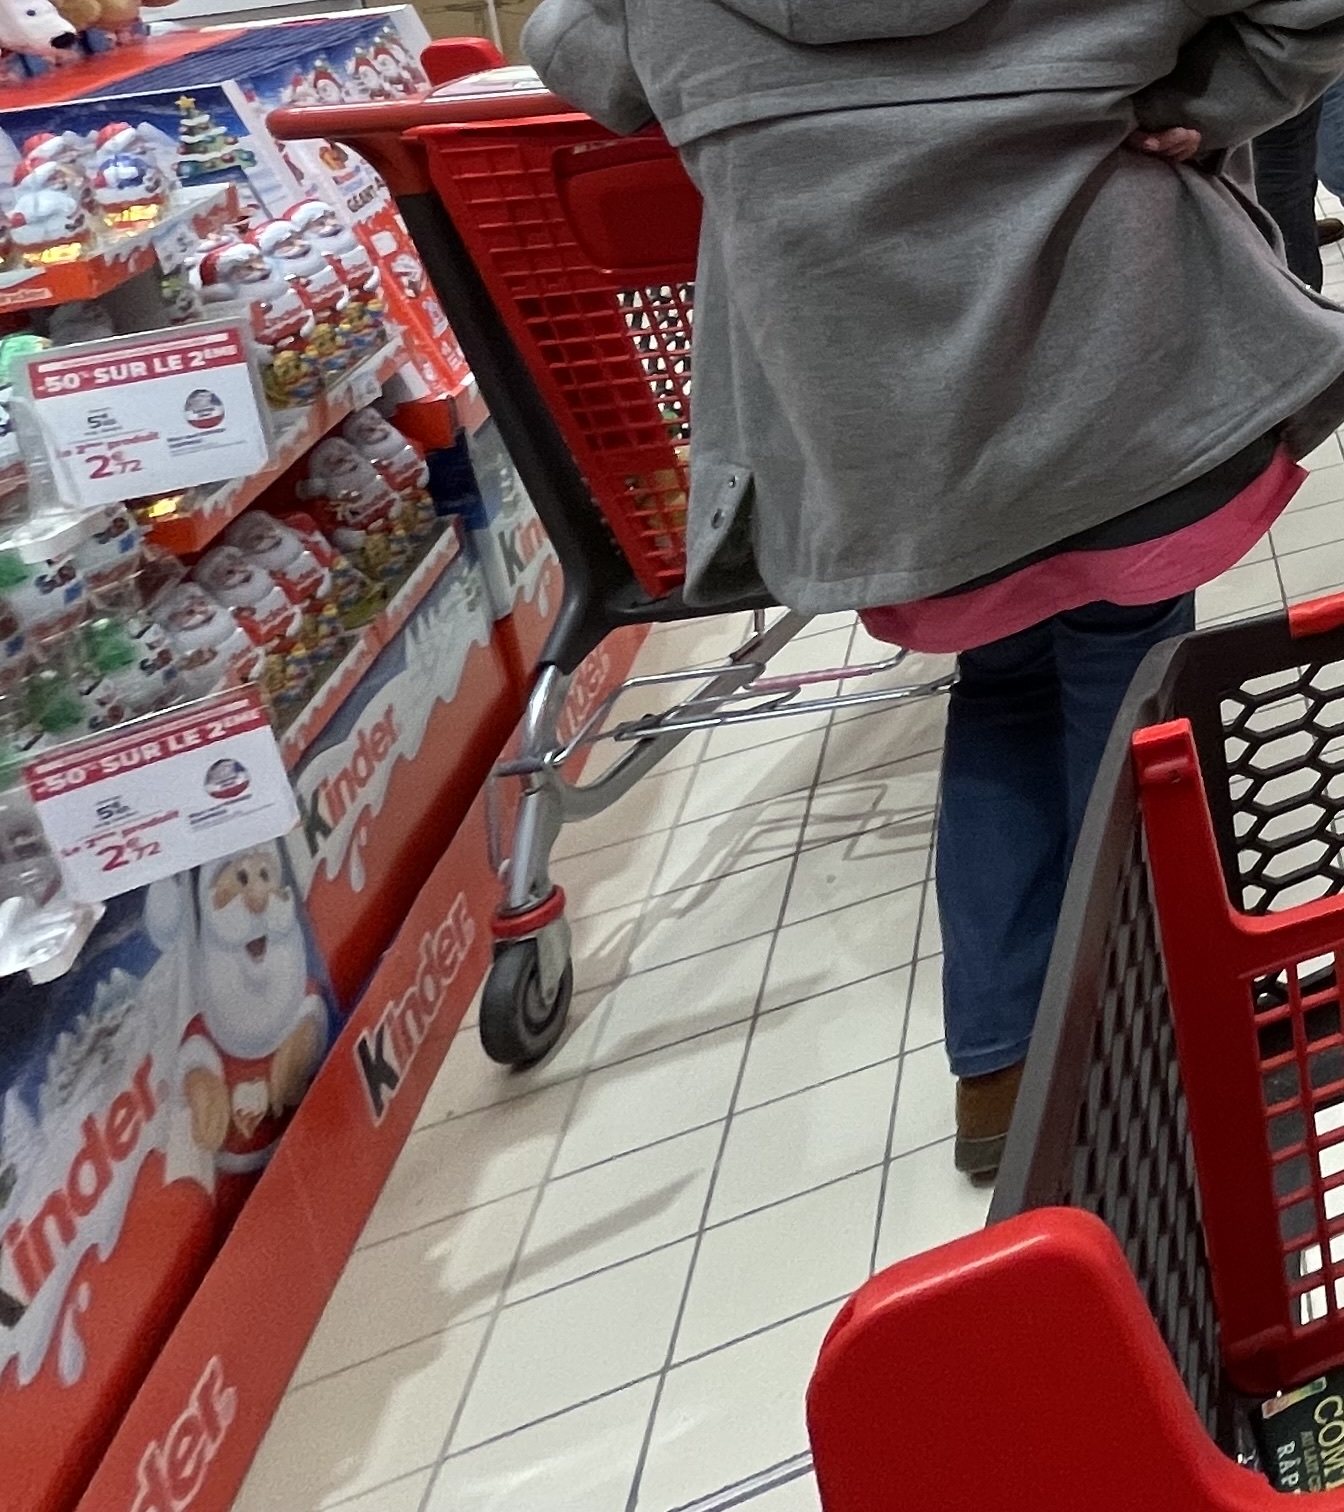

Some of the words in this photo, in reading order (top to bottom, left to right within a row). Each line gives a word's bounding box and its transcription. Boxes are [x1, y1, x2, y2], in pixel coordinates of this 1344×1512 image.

[93, 361, 148, 385] SUR
[152, 353, 183, 374] LE
[100, 741, 163, 774] SUR
[166, 730, 201, 752] LE
[302, 703, 401, 859] Kinder
[355, 891, 476, 1126] Kinder
